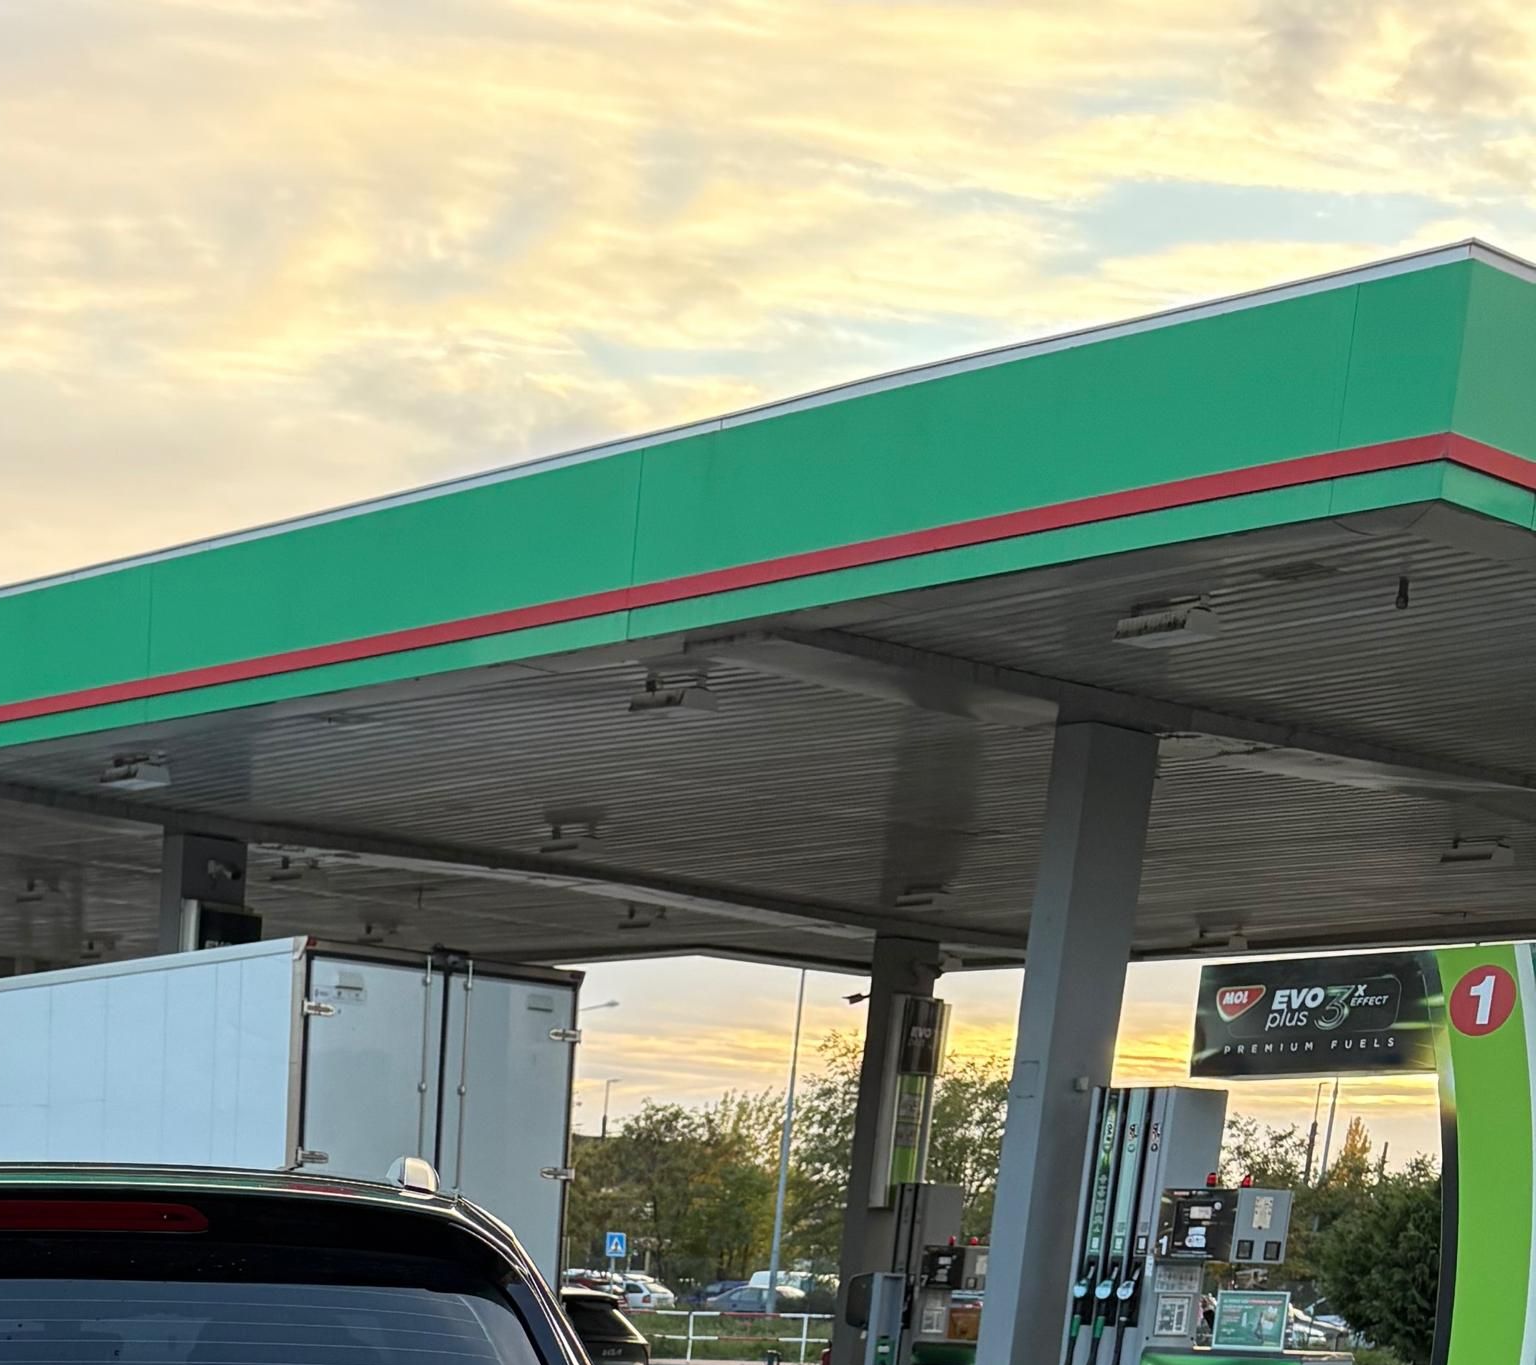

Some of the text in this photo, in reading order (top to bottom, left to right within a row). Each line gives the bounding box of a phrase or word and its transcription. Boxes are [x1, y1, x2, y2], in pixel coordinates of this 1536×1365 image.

[1222, 990, 1249, 1006] MOL
[1271, 986, 1325, 1011] EVO
[1350, 995, 1390, 1007] EFFECT
[1470, 975, 1496, 1025] 1
[1264, 1008, 1309, 1032] plus
[1224, 1037, 1395, 1055] PREMIUM FUELS
[1159, 1235, 1169, 1256] 1
